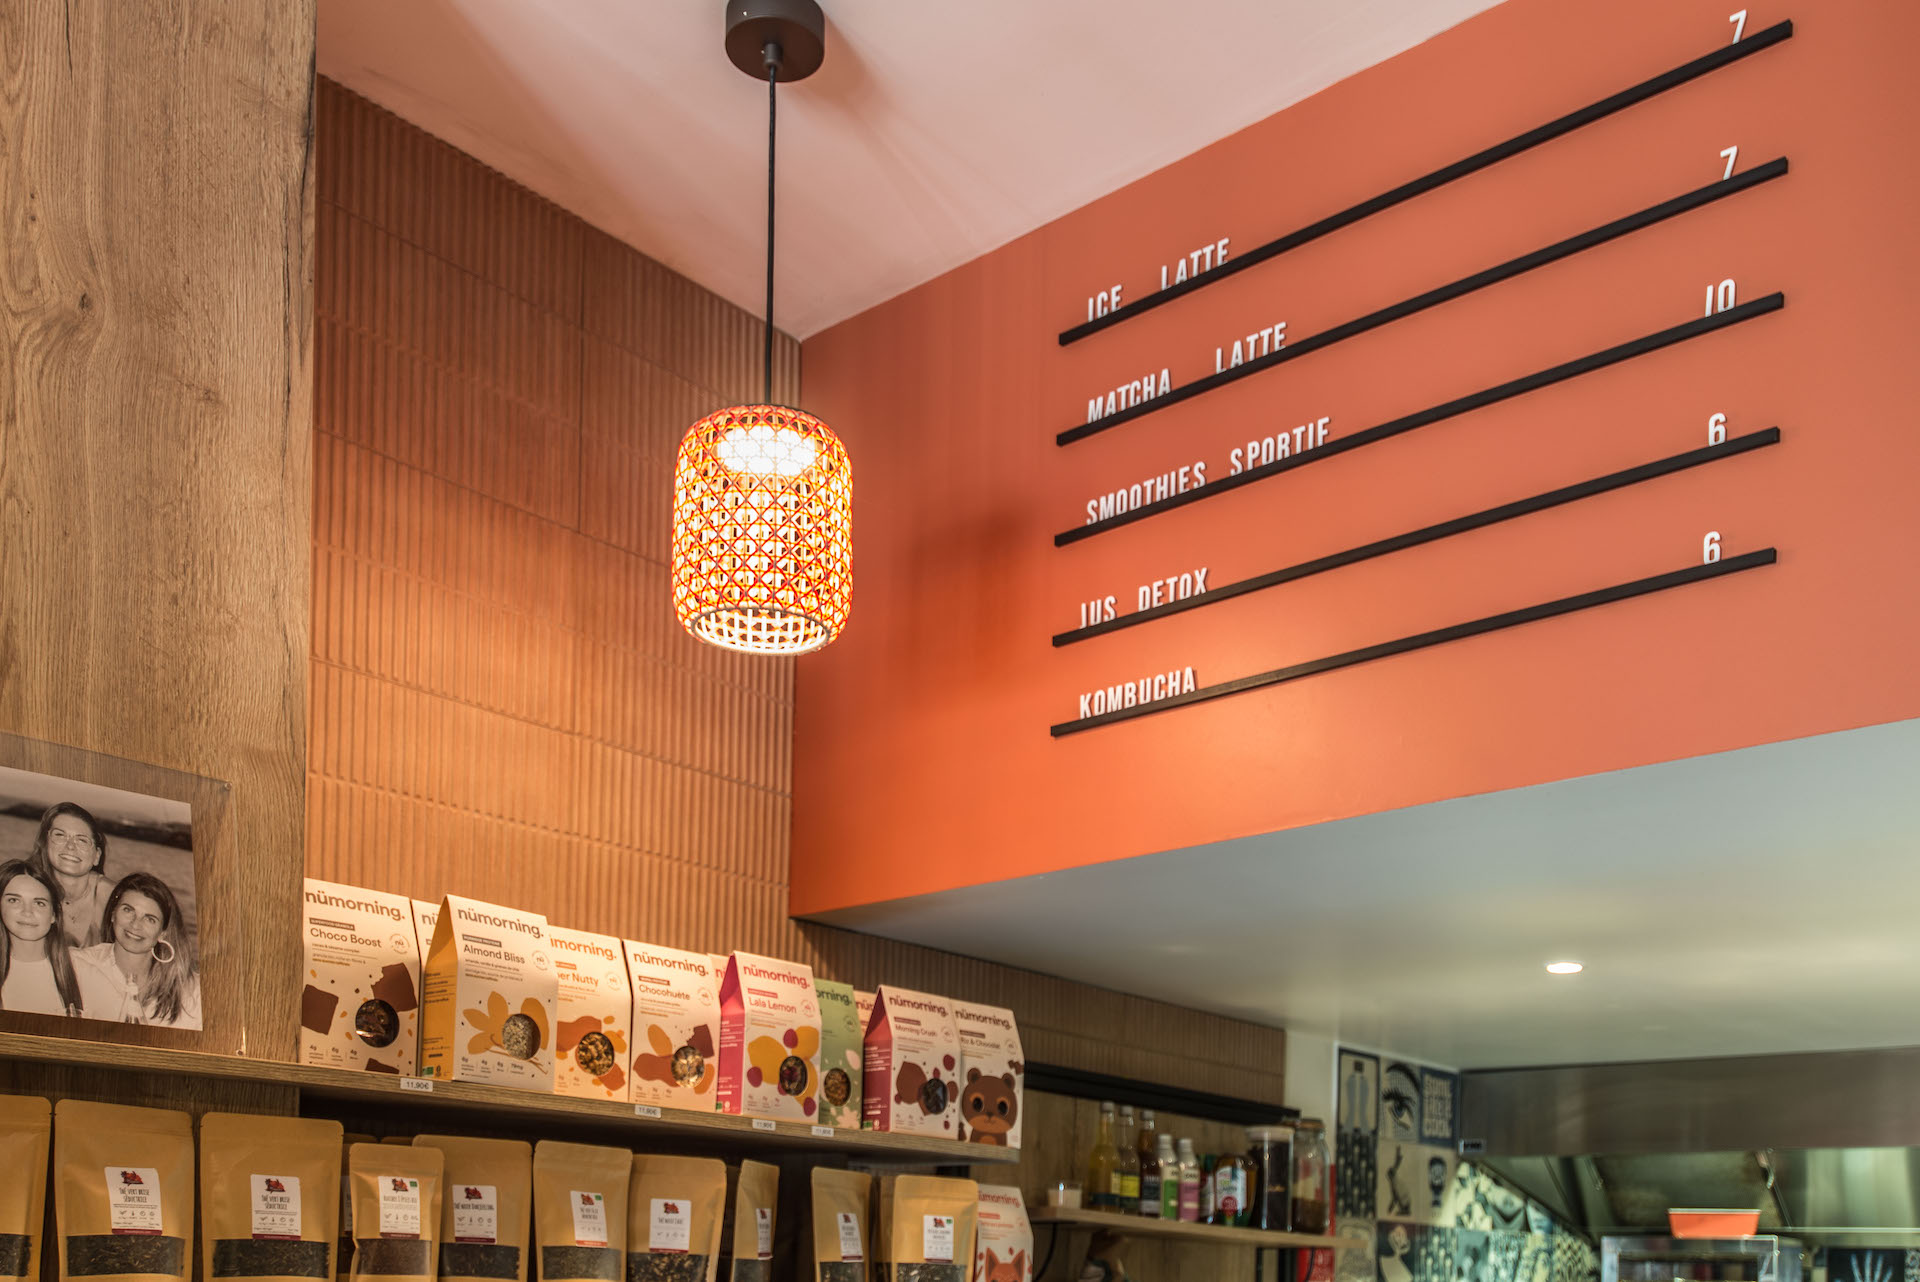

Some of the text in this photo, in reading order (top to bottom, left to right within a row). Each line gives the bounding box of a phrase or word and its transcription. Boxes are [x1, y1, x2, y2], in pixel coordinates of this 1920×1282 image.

[1088, 9, 1747, 322] ICE LATTE 7
[1087, 145, 1738, 423] MATCHA LATTE 7
[1086, 279, 1736, 525] SMOOTHIES SPORTIF 10
[1138, 567, 1208, 612] DETOX
[1708, 412, 1727, 447] 6
[1079, 531, 1722, 719] KOMBUCHA 6
[310, 928, 348, 942] Choco
[350, 934, 382, 948] Boost
[463, 944, 526, 964] Almond Bliss
[549, 933, 617, 961] morning.
[572, 972, 599, 987] Nutty
[768, 1000, 797, 1014] Lemon
